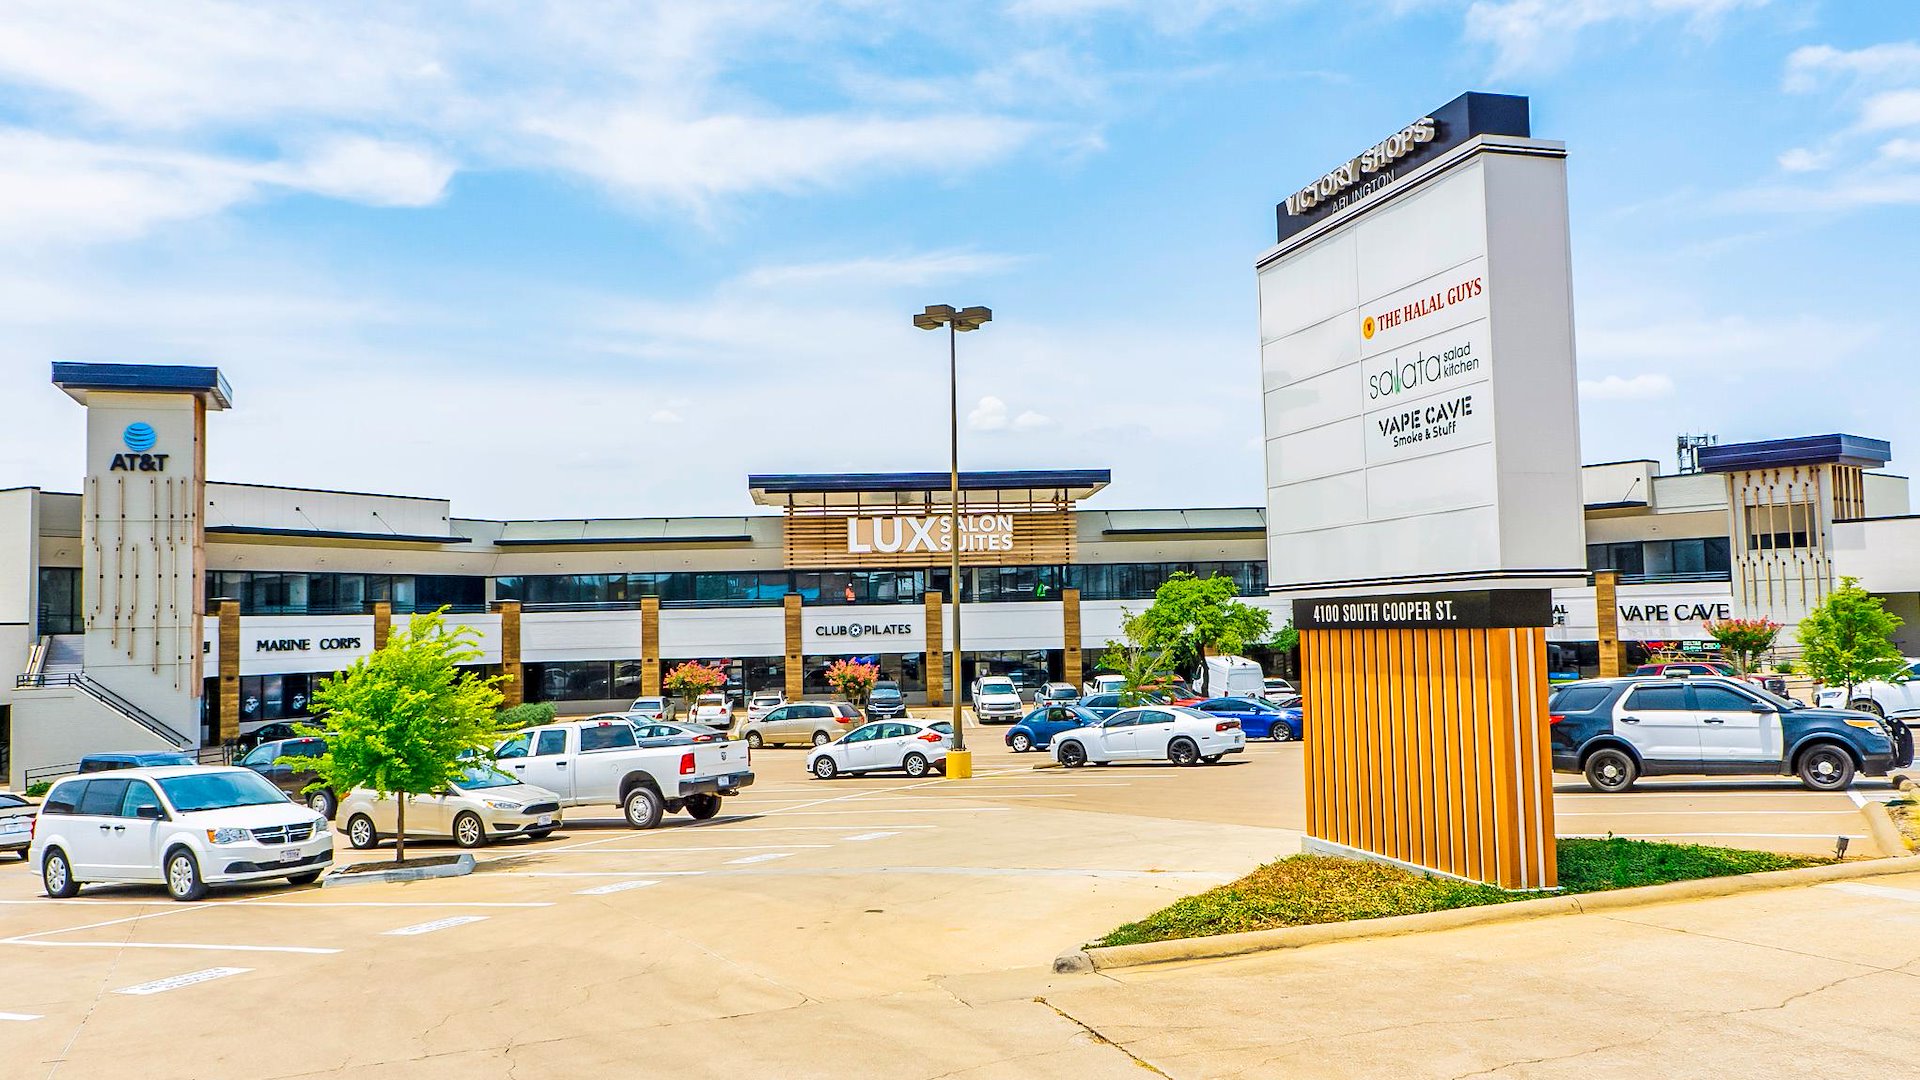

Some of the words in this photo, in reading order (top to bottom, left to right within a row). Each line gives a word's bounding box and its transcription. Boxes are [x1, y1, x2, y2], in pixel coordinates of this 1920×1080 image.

[1285, 157, 1361, 216] VICTORY
[1361, 116, 1435, 173] SHOPS
[1331, 169, 1395, 214] ARLINGTON
[1378, 308, 1401, 331] THE
[1404, 292, 1445, 322] HALAL
[1447, 277, 1482, 305] GUYS
[1443, 341, 1471, 362] salad
[1369, 351, 1441, 400] salata
[1443, 358, 1479, 378] kitchen
[1378, 409, 1420, 437] VAPE
[1425, 395, 1472, 424] CAVE
[1393, 432, 1423, 447] Smoke
[1425, 428, 1431, 440] &
[1432, 421, 1457, 438] Stuff
[110, 453, 169, 472] AT&T
[939, 514, 1013, 533] SALON
[847, 516, 941, 553] LUX
[939, 533, 1013, 552] SUITES
[1313, 605, 1339, 622] 4100
[1342, 603, 1379, 622] SOUTH
[1382, 601, 1431, 621] COOPER
[1435, 600, 1457, 620] ST.
[1619, 605, 1668, 621] VAPE
[1674, 603, 1729, 621] CAVE
[816, 626, 847, 636] CLUB
[864, 624, 911, 635] PILATES
[256, 639, 311, 651] MARINE
[319, 637, 361, 650] CORPS
